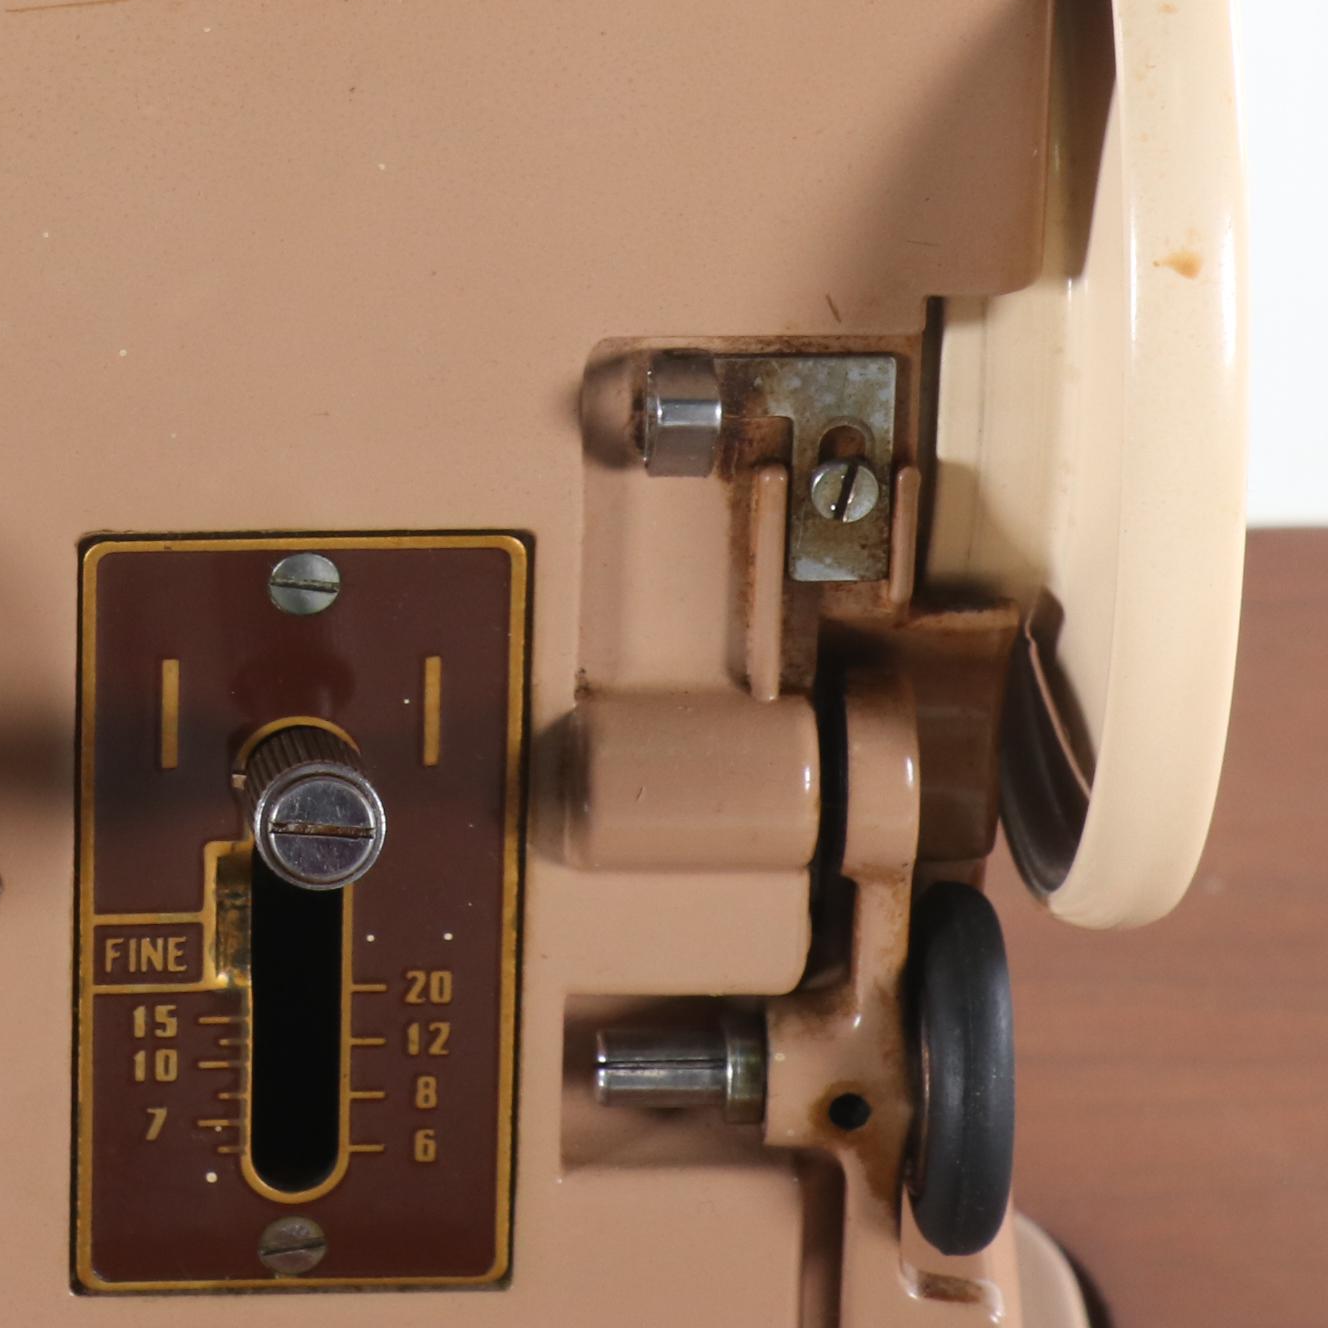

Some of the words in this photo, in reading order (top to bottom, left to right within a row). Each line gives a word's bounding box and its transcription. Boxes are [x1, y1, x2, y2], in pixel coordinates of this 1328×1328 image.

[106, 937, 186, 972] FINE
[406, 971, 452, 1003] 20
[134, 1005, 177, 1037] 15
[408, 1022, 450, 1055] 12
[135, 1049, 177, 1081] 10
[416, 1077, 437, 1108] 8
[147, 1108, 167, 1140] 7
[415, 1130, 436, 1161] 6
